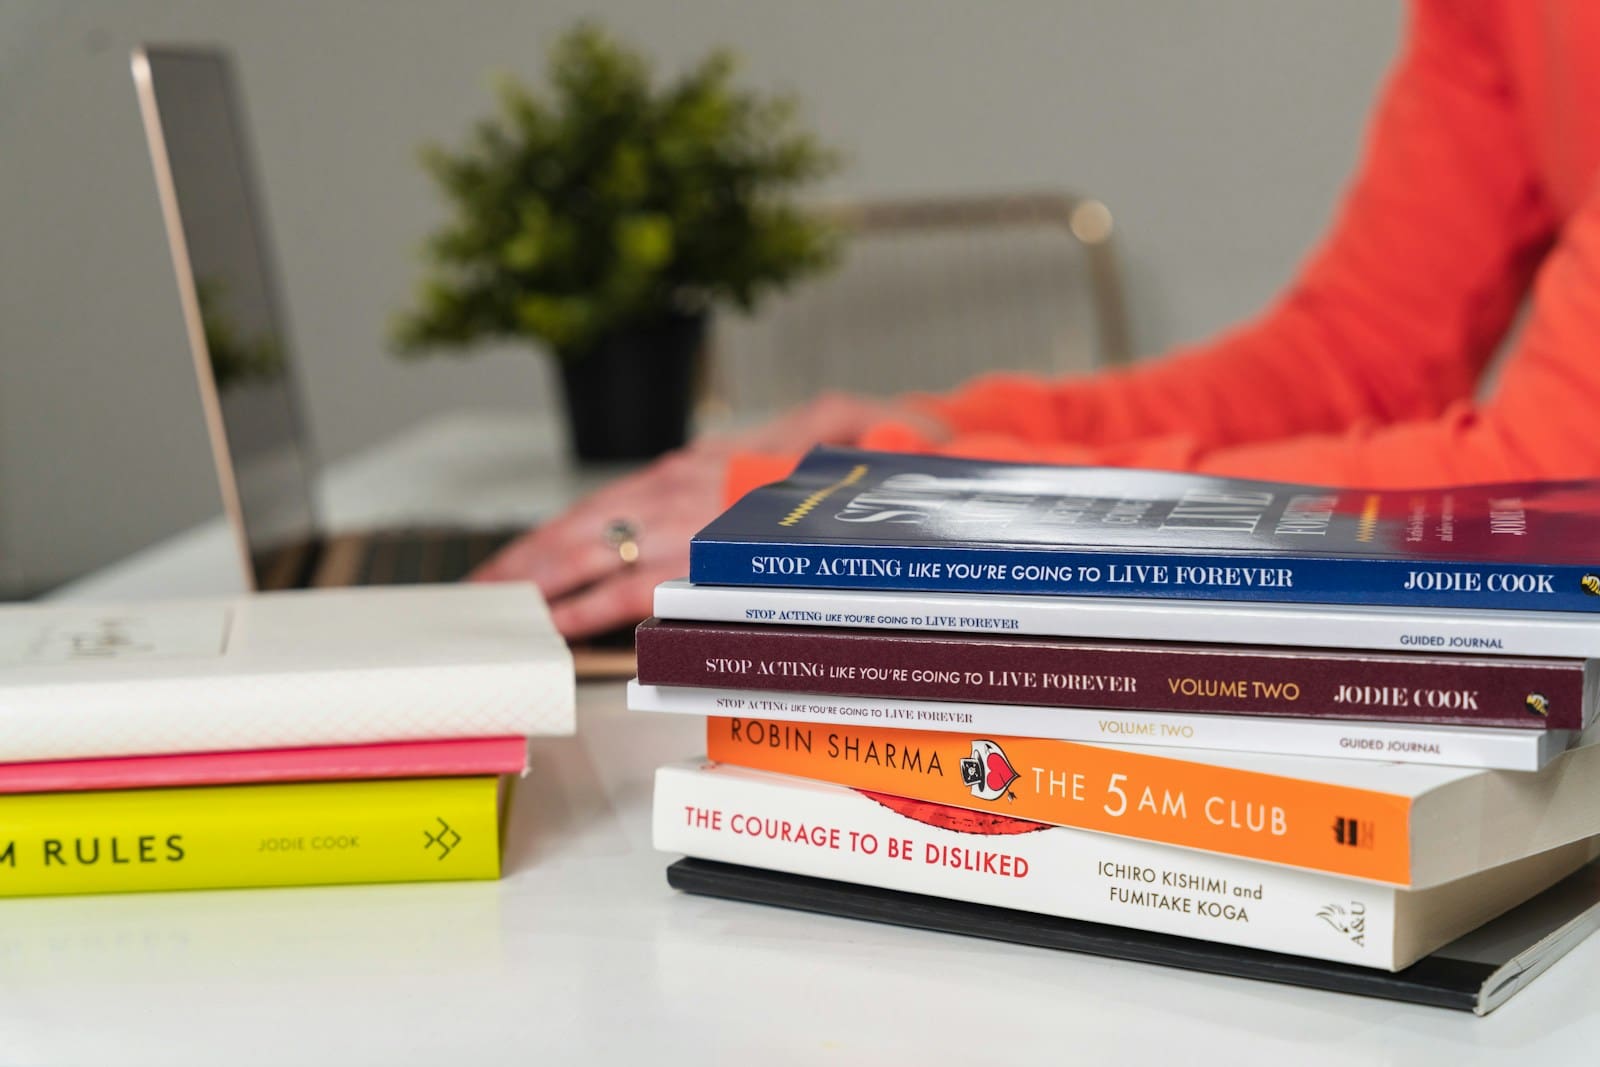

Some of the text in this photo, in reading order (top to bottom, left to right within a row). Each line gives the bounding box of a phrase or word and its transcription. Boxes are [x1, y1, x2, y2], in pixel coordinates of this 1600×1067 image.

[752, 556, 1293, 588] STOP ACTING LIKE YOU'RE GOING TO LIVE FOREVER
[1403, 571, 1555, 594] JODIE COOK
[745, 608, 1020, 630] STOP ACTING LIKE YOU'RE GOING TO LIVE FOREVER
[1399, 635, 1504, 649] GUIDED JOURNAL
[705, 657, 1137, 693] STOP ACTING LIKE YOU'RE GOING TO LIVE FOREVER
[1167, 677, 1300, 701] VOLUME TWO
[1333, 684, 1479, 711] JODIE COOK
[715, 697, 974, 724] STOP ACTING LIKE YOU'RE GOING TO LIVE FOREVER
[1098, 719, 1195, 739] VOLUME TWO
[731, 717, 944, 777] ROBIN SHARMA
[1339, 737, 1441, 754] GUIDED JOURNAL
[1031, 767, 1288, 837] THE 5 AM CLUB
[43, 834, 185, 867] RULES
[258, 836, 360, 853] JODIE COOK
[685, 806, 1030, 879] THE COURAGE TO BE DISLIKED
[1097, 861, 1264, 901] ICHIRO KISHIMI and
[1109, 887, 1250, 924] FUMITAKE KOGA
